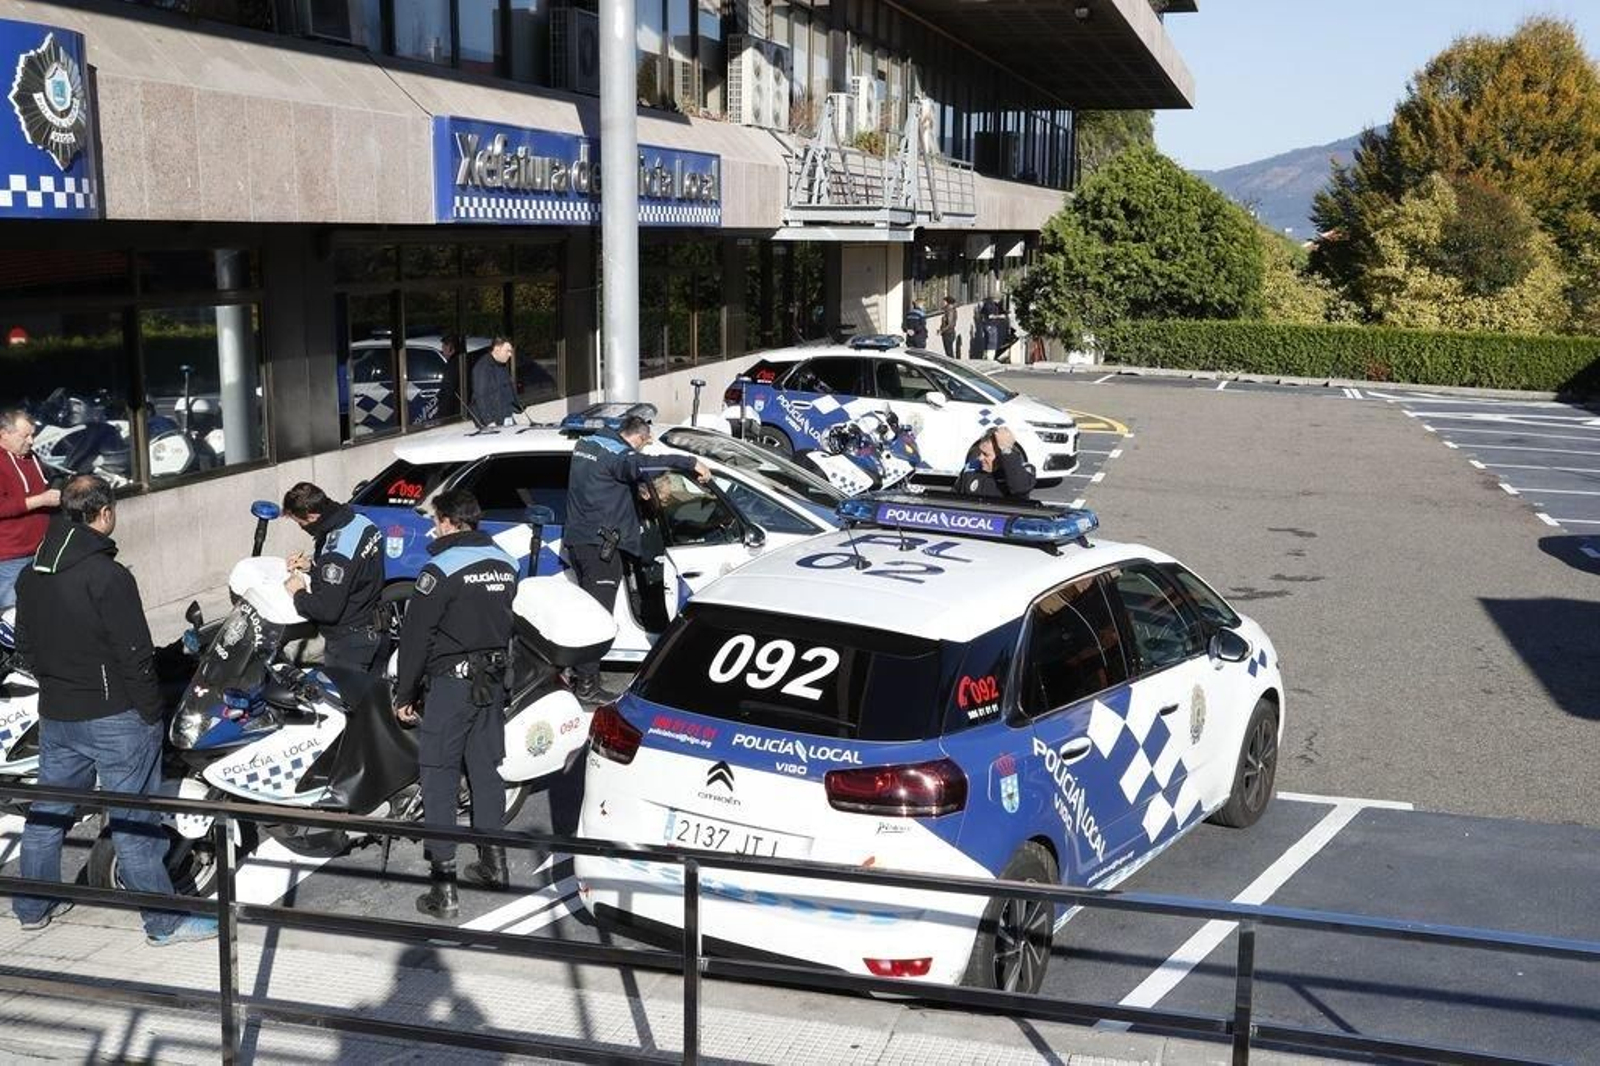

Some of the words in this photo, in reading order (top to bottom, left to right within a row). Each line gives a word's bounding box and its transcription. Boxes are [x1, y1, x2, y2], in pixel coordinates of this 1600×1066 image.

[455, 132, 568, 192] Xefatura
[400, 484, 423, 498] 092
[885, 508, 939, 526] POLICÍA
[950, 515, 994, 531] LOCAL
[708, 633, 840, 701] 092
[970, 676, 1000, 704] 092
[560, 716, 580, 735] 092
[282, 738, 320, 759] LOCAL
[732, 734, 794, 754] POLICÍA
[808, 746, 863, 765] LOCAL
[775, 762, 807, 775] VIGO
[1032, 737, 1081, 811] POLICÍA
[1080, 807, 1106, 863] LOCAL
[1054, 792, 1073, 831] VIGO
[676, 820, 730, 850] 2137
